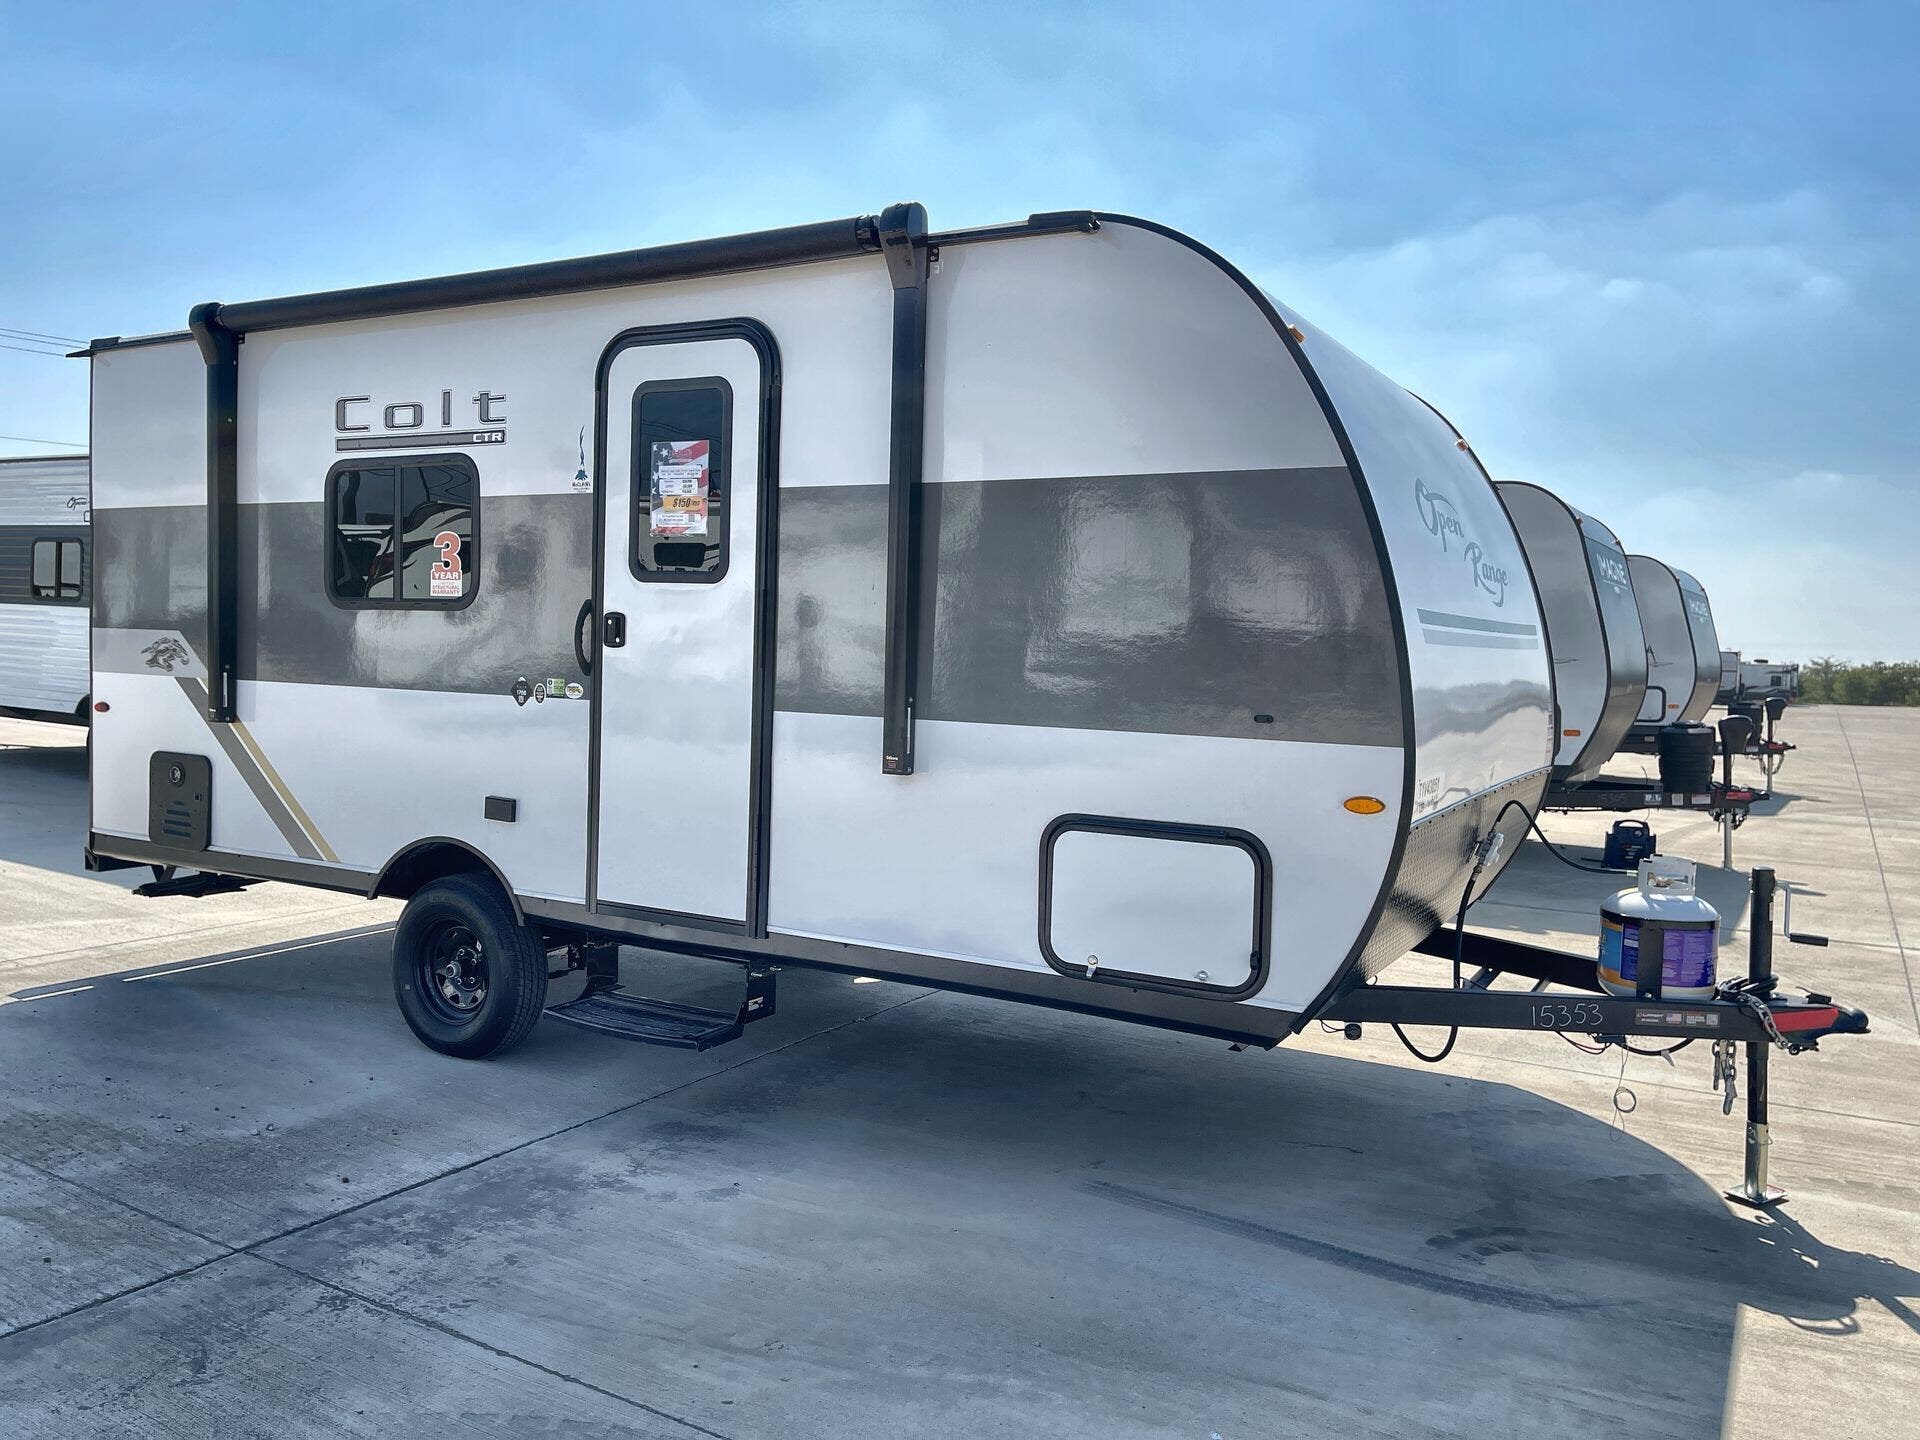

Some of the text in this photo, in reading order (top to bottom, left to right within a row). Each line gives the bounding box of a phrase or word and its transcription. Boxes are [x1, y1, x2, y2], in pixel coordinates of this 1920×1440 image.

[336, 389, 507, 433] Colt
[473, 432, 503, 443] CTR
[433, 531, 462, 571] 3
[1414, 477, 1509, 608] Open Range
[433, 571, 459, 580] YEAR
[1532, 1003, 1604, 1028] 15353
